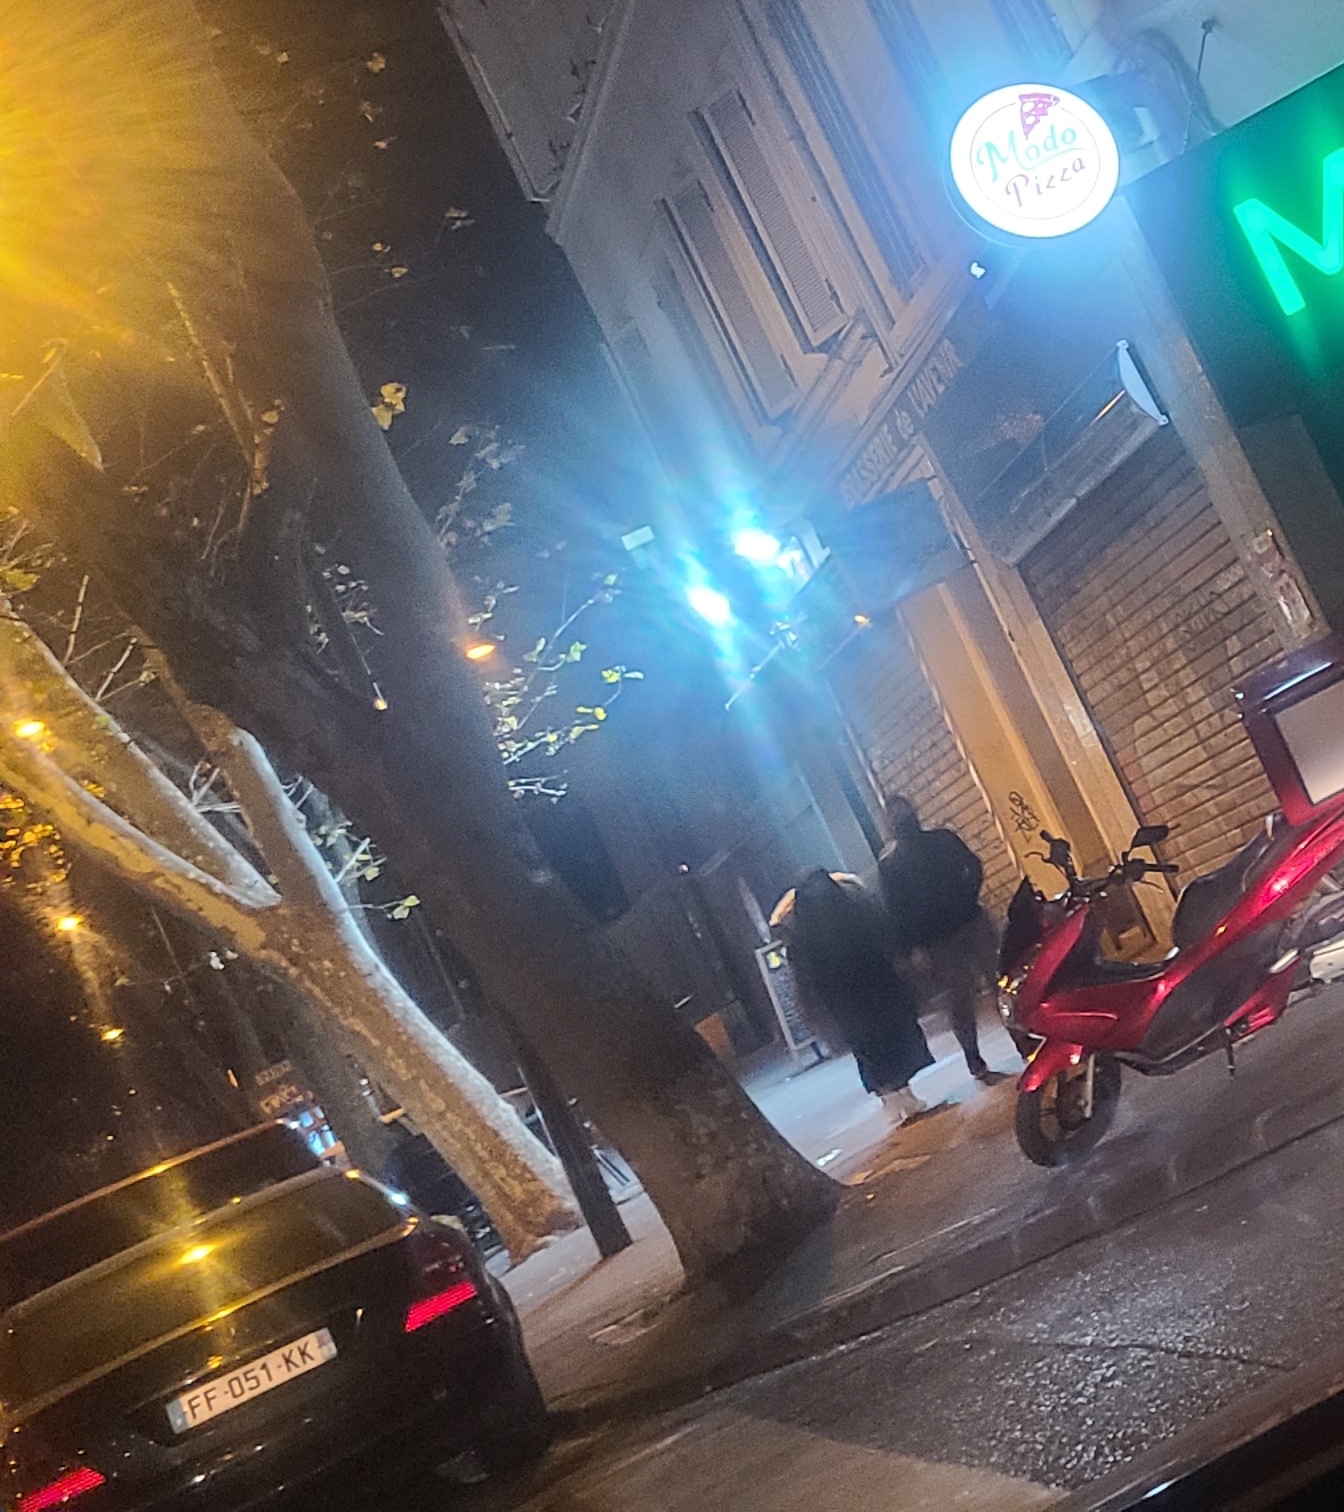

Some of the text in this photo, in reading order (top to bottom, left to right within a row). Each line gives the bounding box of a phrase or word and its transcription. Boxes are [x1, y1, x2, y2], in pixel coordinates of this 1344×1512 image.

[976, 124, 1080, 183] Modo
[1004, 157, 1086, 207] Pizza
[187, 1341, 316, 1420] FF-051-KK
